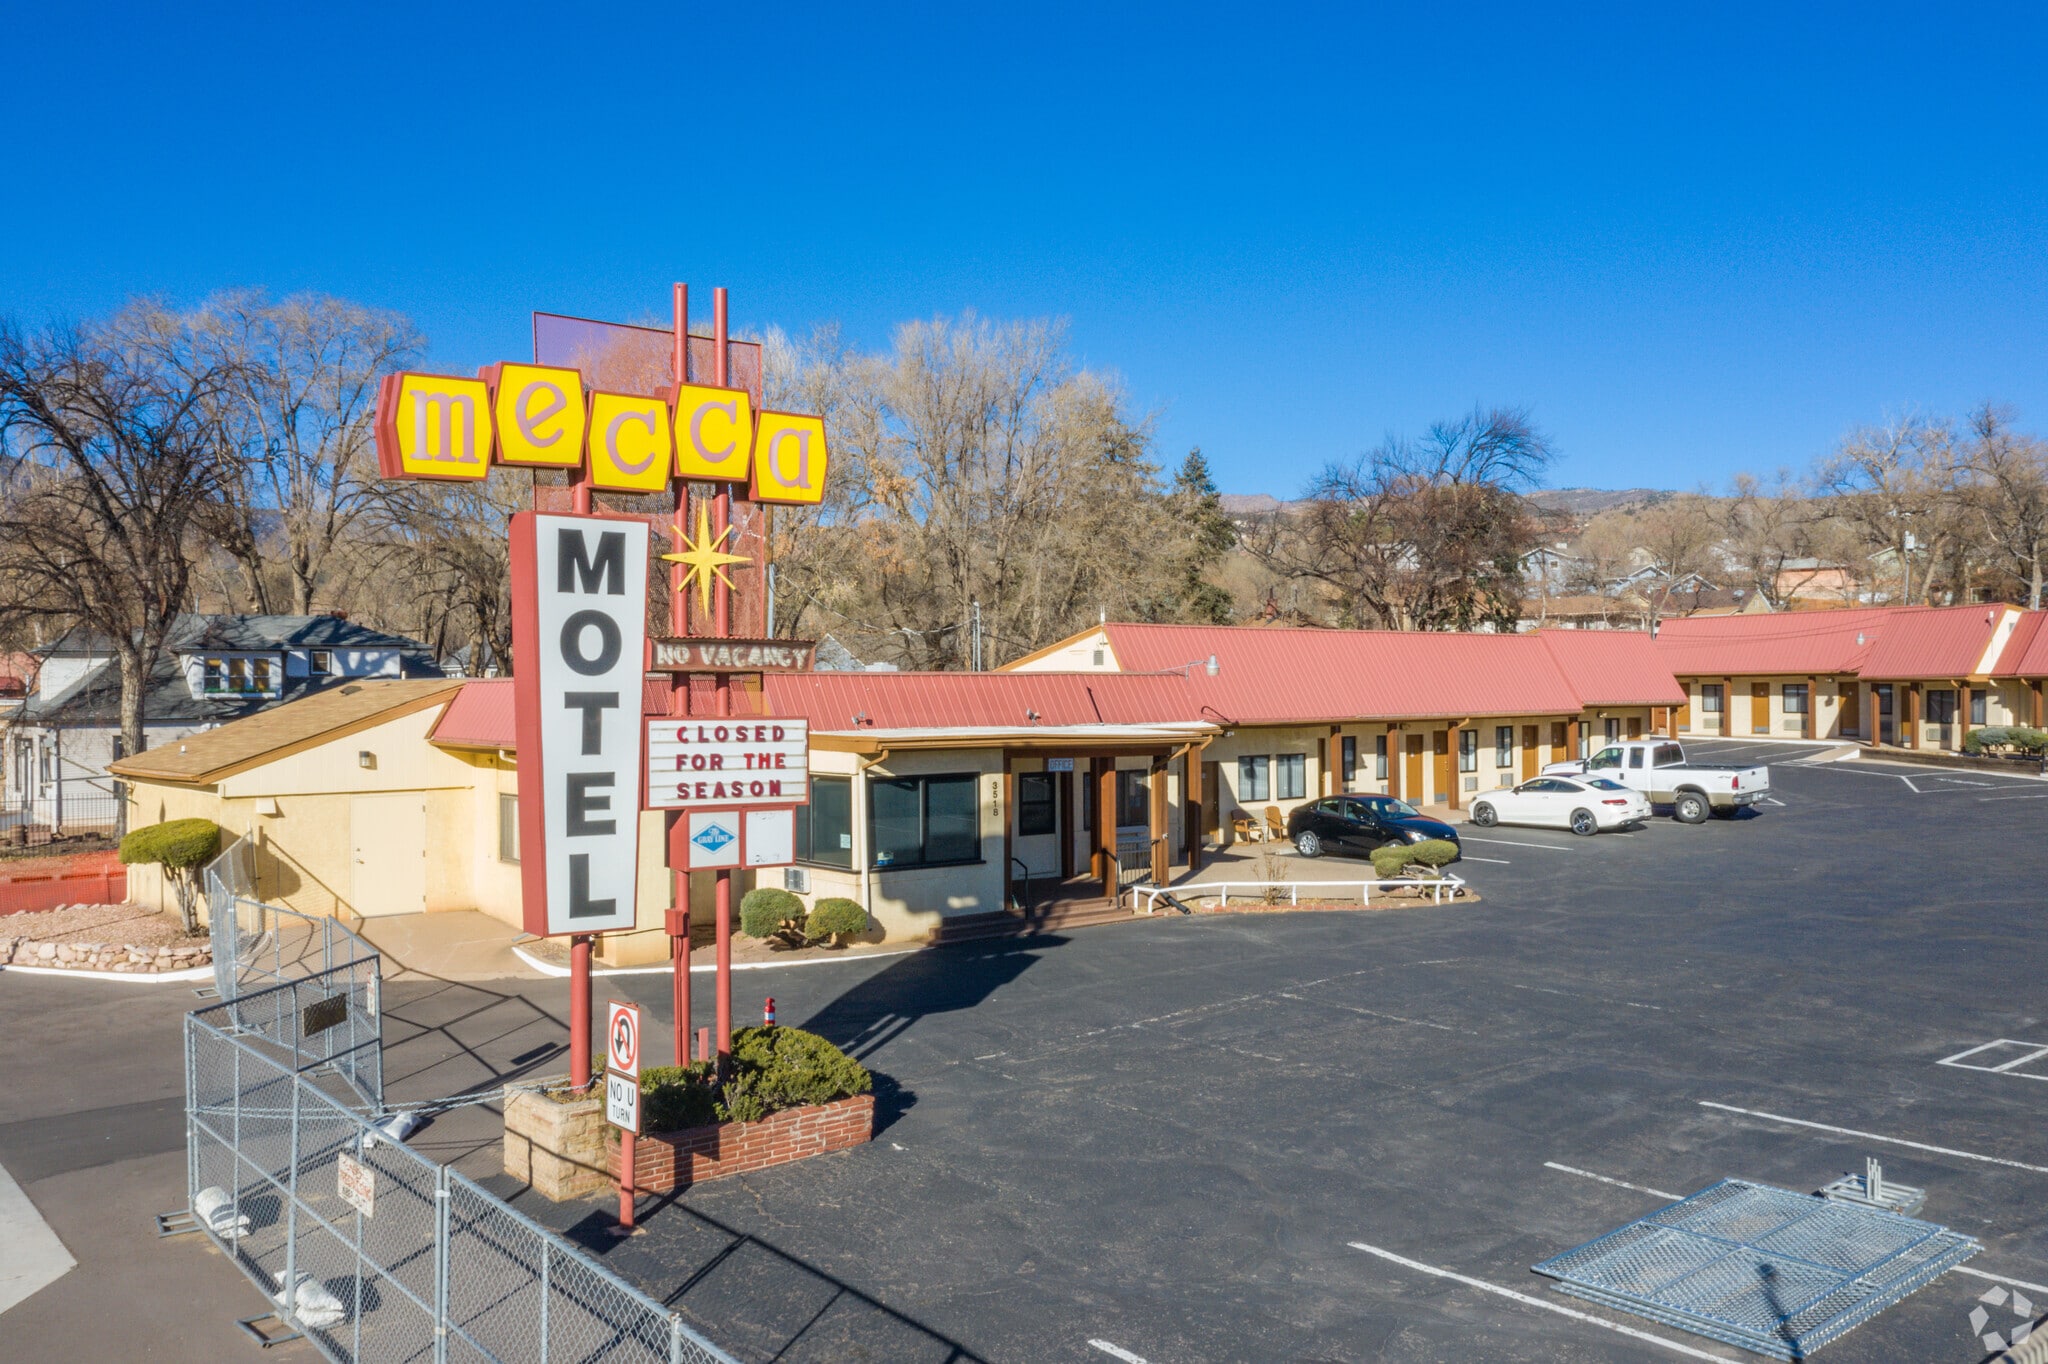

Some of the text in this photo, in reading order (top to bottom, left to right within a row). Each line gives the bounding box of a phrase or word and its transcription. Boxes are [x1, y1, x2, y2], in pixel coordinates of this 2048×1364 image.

[410, 381, 812, 489] mecca
[657, 643, 808, 669] NO VACANCY
[557, 528, 626, 919] MOTEL
[676, 725, 785, 744] CLOSED
[676, 752, 787, 772] FOR THE
[1049, 759, 1073, 770] OFFICE
[676, 779, 782, 800] SEASON
[697, 834, 729, 844] GRAY LINE
[610, 1080, 635, 1107] NO U
[612, 1104, 630, 1124] TURN
